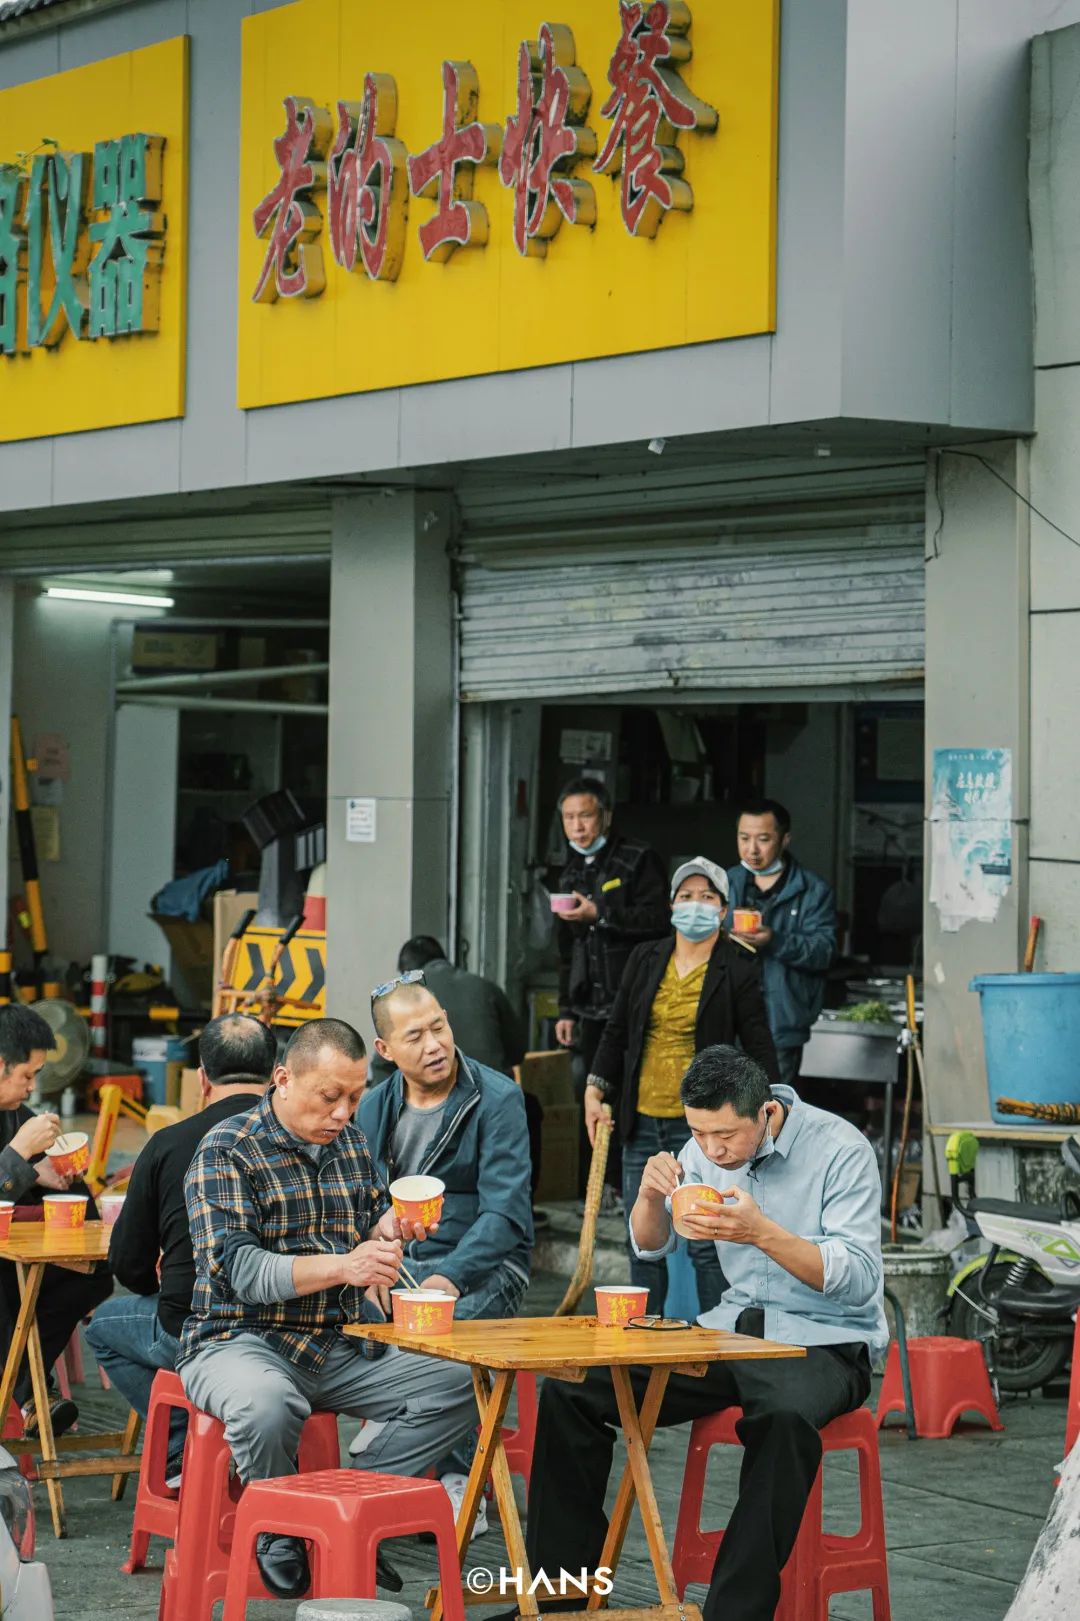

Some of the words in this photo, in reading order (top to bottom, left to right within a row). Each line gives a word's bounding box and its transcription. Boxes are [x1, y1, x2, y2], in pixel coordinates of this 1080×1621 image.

[252, 0, 708, 303] 老的士快餐
